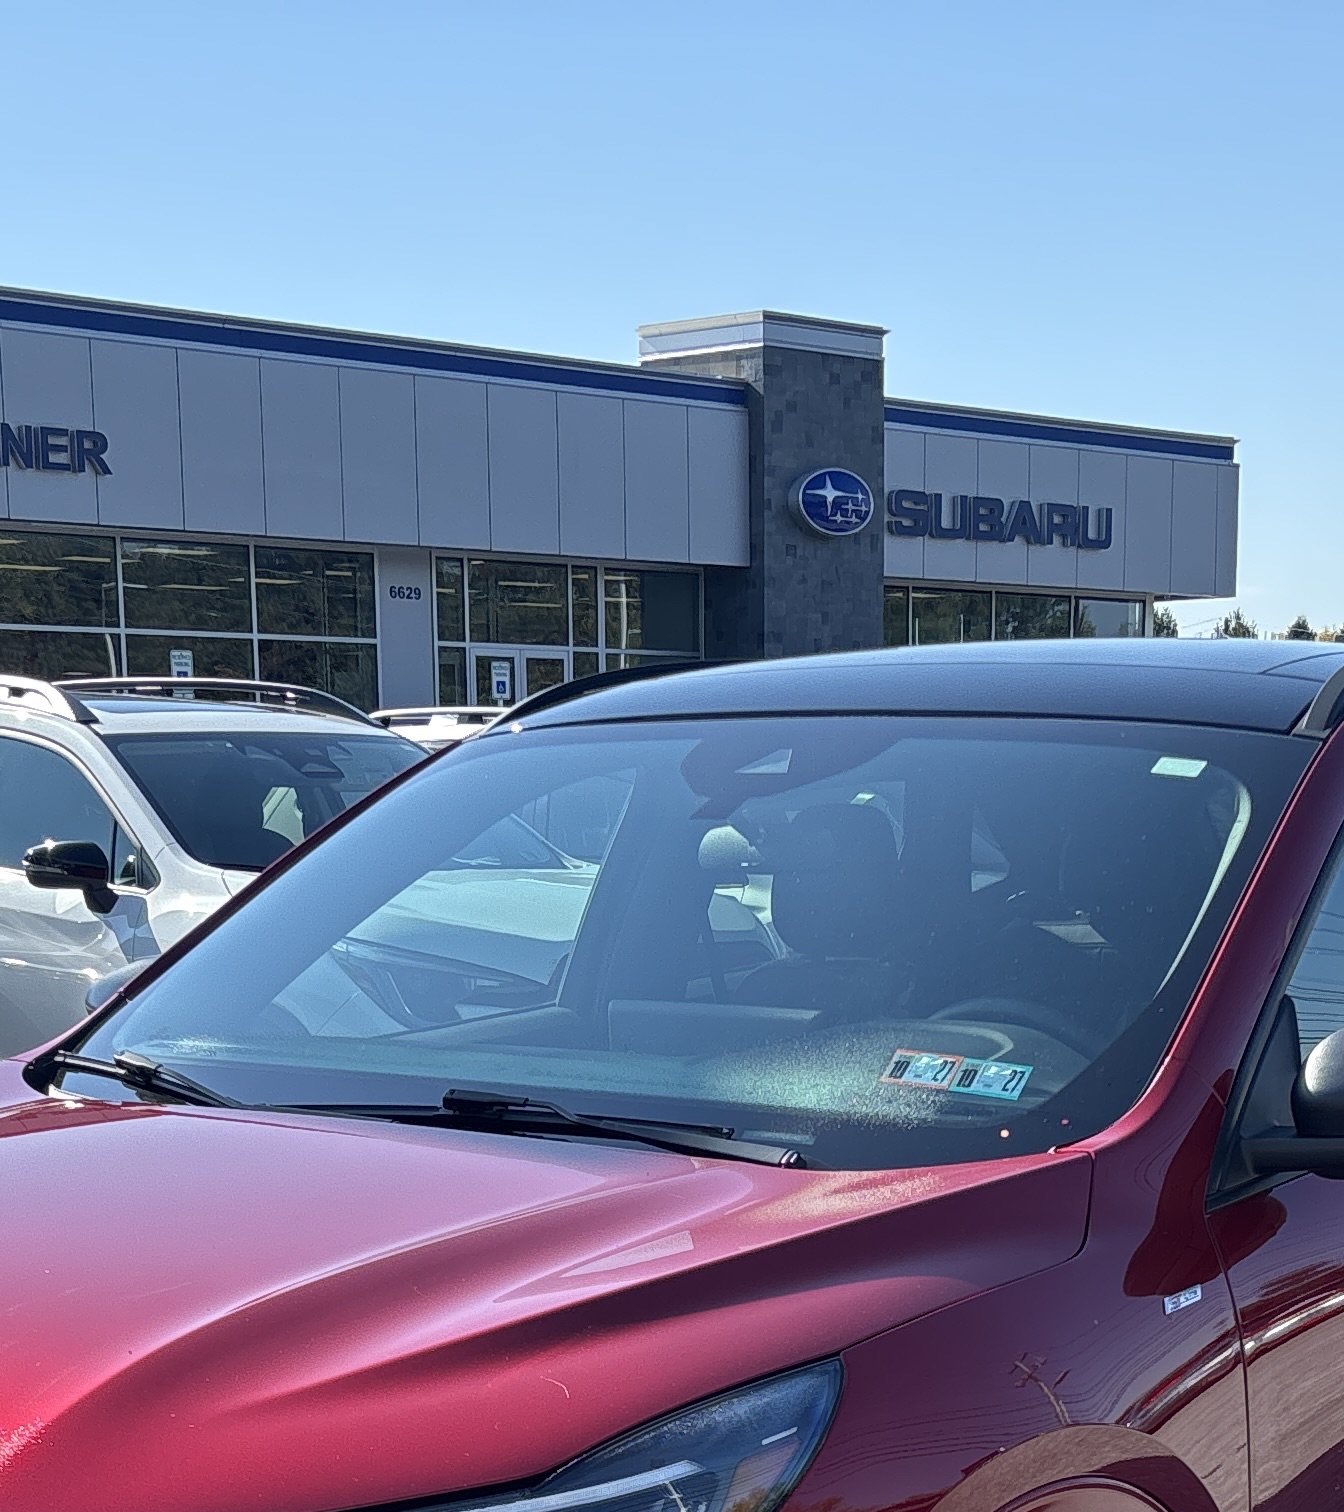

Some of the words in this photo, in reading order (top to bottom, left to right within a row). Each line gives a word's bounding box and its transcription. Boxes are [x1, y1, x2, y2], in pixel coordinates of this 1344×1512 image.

[887, 489, 1113, 550] SUBARU
[389, 585, 422, 600] 6629
[888, 1059, 910, 1079] 10
[931, 1059, 956, 1084] 27
[956, 1068, 978, 1088] 10
[1001, 1069, 1026, 1094] 27
